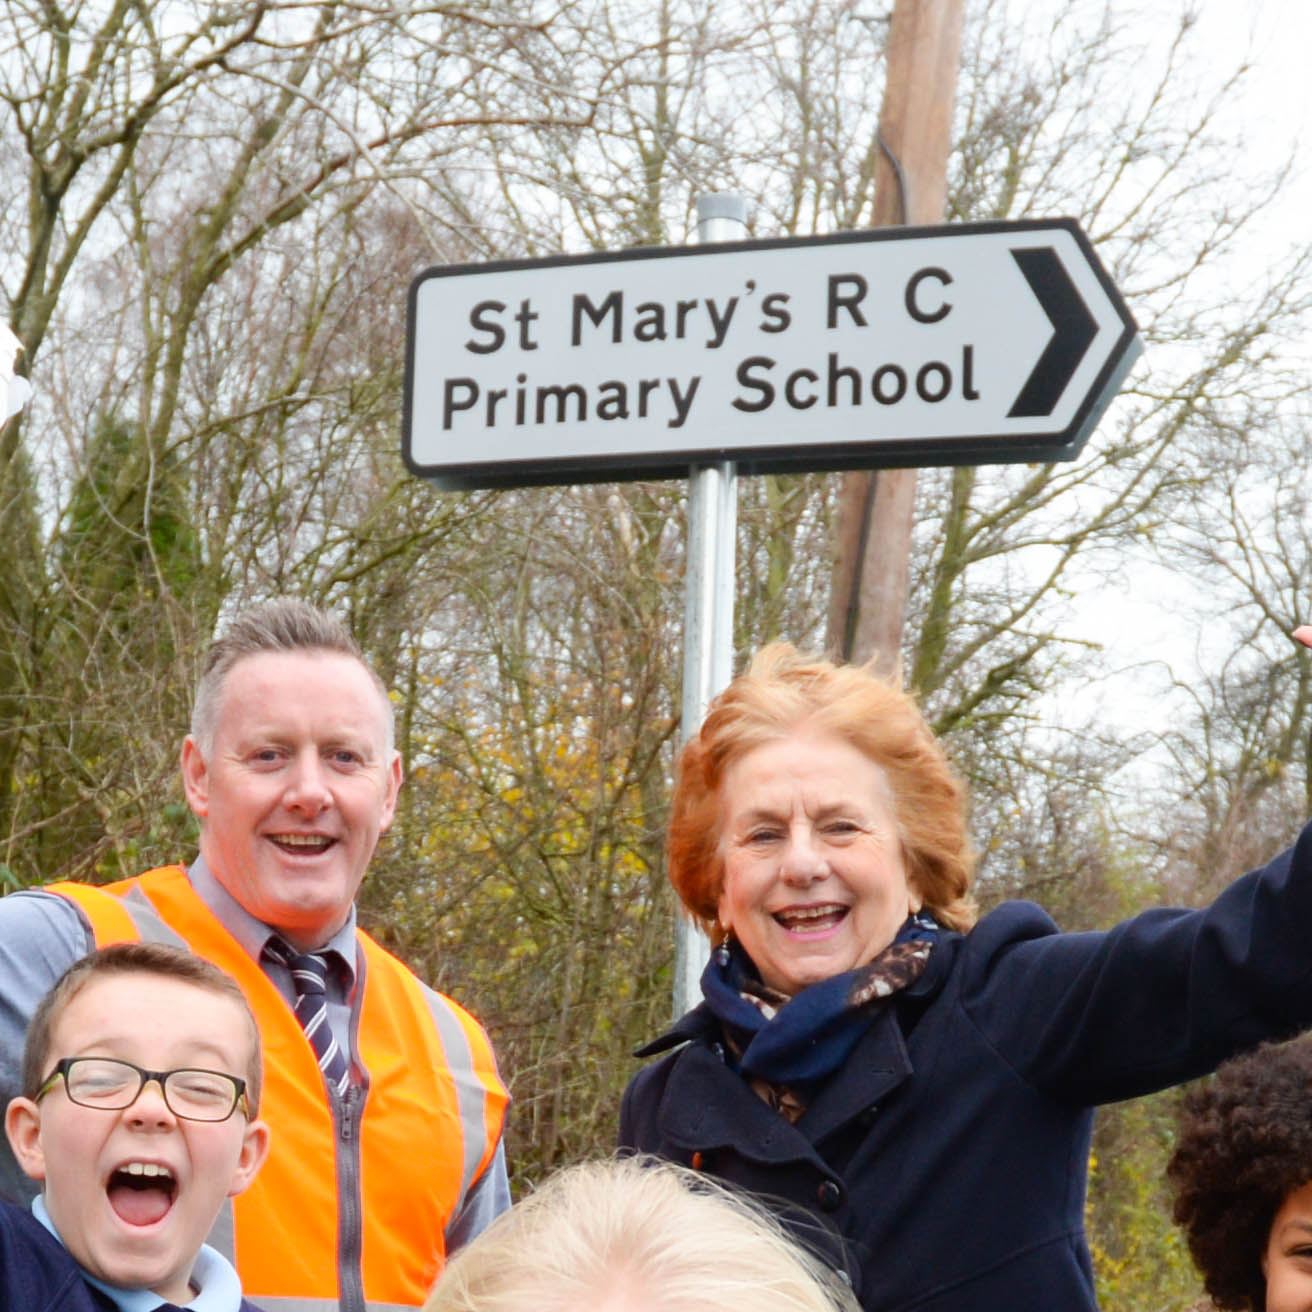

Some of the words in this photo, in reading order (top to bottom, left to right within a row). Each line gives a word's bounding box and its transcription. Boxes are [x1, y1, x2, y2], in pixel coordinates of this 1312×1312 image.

[465, 300, 538, 354] St
[571, 279, 792, 350] Mary's
[827, 272, 869, 329] R
[904, 267, 954, 325] C
[443, 372, 701, 430] Primary
[731, 344, 979, 413] School
